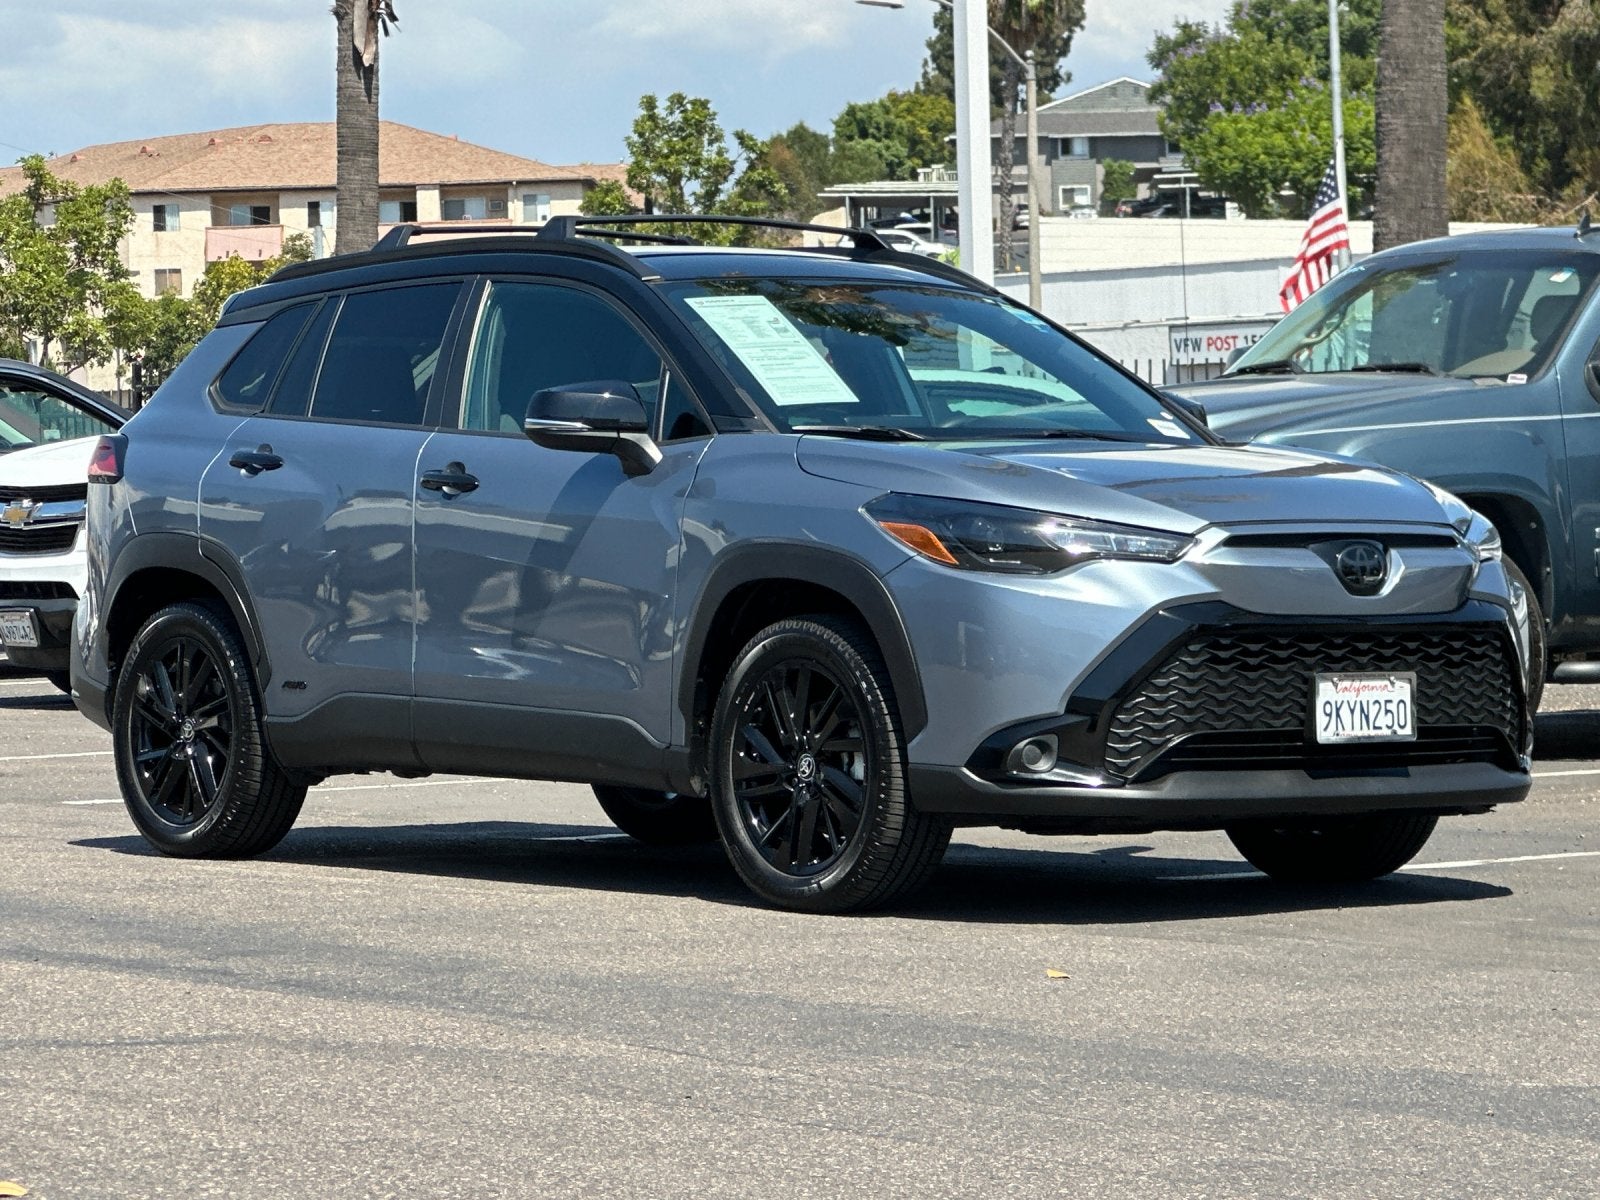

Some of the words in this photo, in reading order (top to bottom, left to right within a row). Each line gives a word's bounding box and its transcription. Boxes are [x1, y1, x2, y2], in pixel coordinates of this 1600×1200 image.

[1174, 337, 1202, 353] VFW
[1206, 335, 1239, 352] POST
[1336, 680, 1395, 698] California
[1322, 699, 1408, 732] 9KYN250
